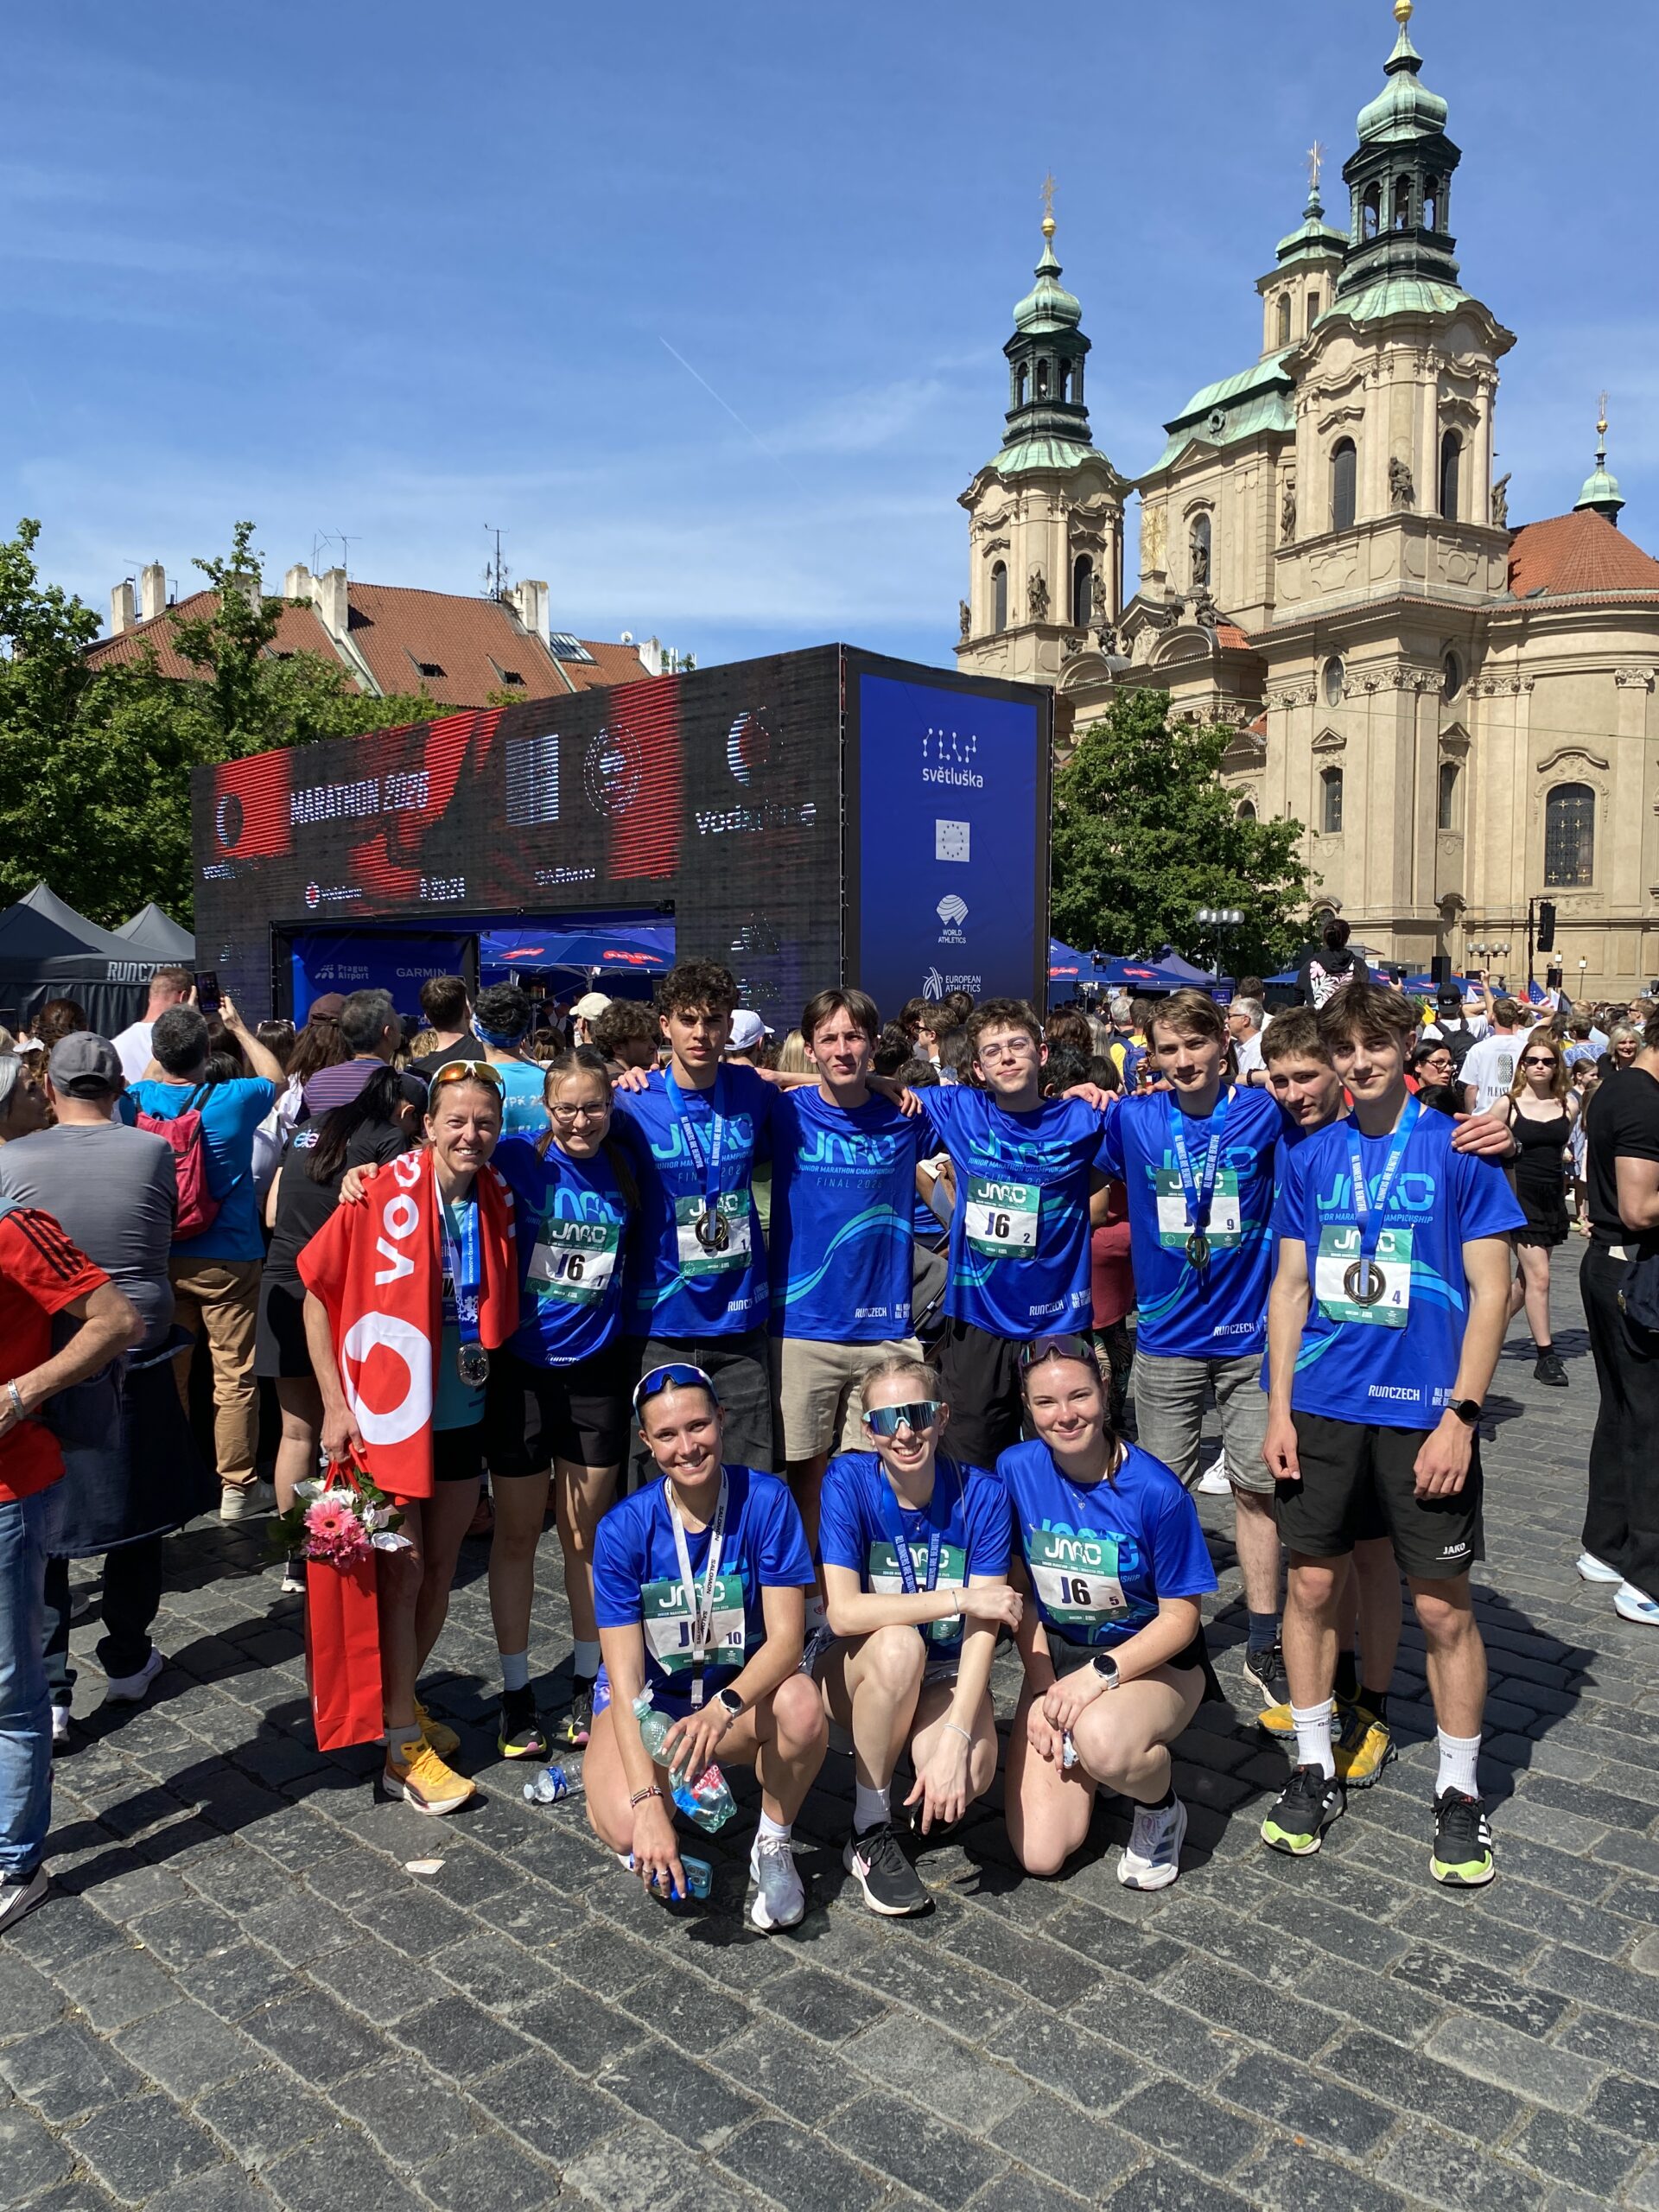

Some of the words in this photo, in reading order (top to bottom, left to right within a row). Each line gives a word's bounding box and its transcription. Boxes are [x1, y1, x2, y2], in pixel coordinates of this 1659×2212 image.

[922, 766, 983, 788] světluška
[106, 961, 181, 982] RUNCZ
[337, 964, 369, 973] Prague
[396, 968, 447, 977] GARMIN
[338, 972, 369, 981] Airport
[945, 984, 981, 993] ATHLETICS
[967, 1157, 989, 1166] JUNIOR
[817, 1177, 849, 1188] FINAL
[984, 1211, 1011, 1238] J6
[1226, 1218, 1234, 1230] 9
[1023, 1232, 1031, 1243] 2
[554, 1254, 585, 1281] J6
[1392, 1290, 1402, 1305] 4
[1029, 1299, 1065, 1316] RUNCZECH
[1213, 1322, 1255, 1337] RUNCZECH
[1368, 1384, 1421, 1401] RUNCZECH
[715, 1505, 724, 1541] SALOMON
[1442, 1541, 1466, 1554] JAKO
[706, 1559, 716, 1595] SALOMON
[1060, 1576, 1091, 1605] J6
[1109, 1596, 1120, 1605] 5
[726, 1631, 742, 1645] 10
